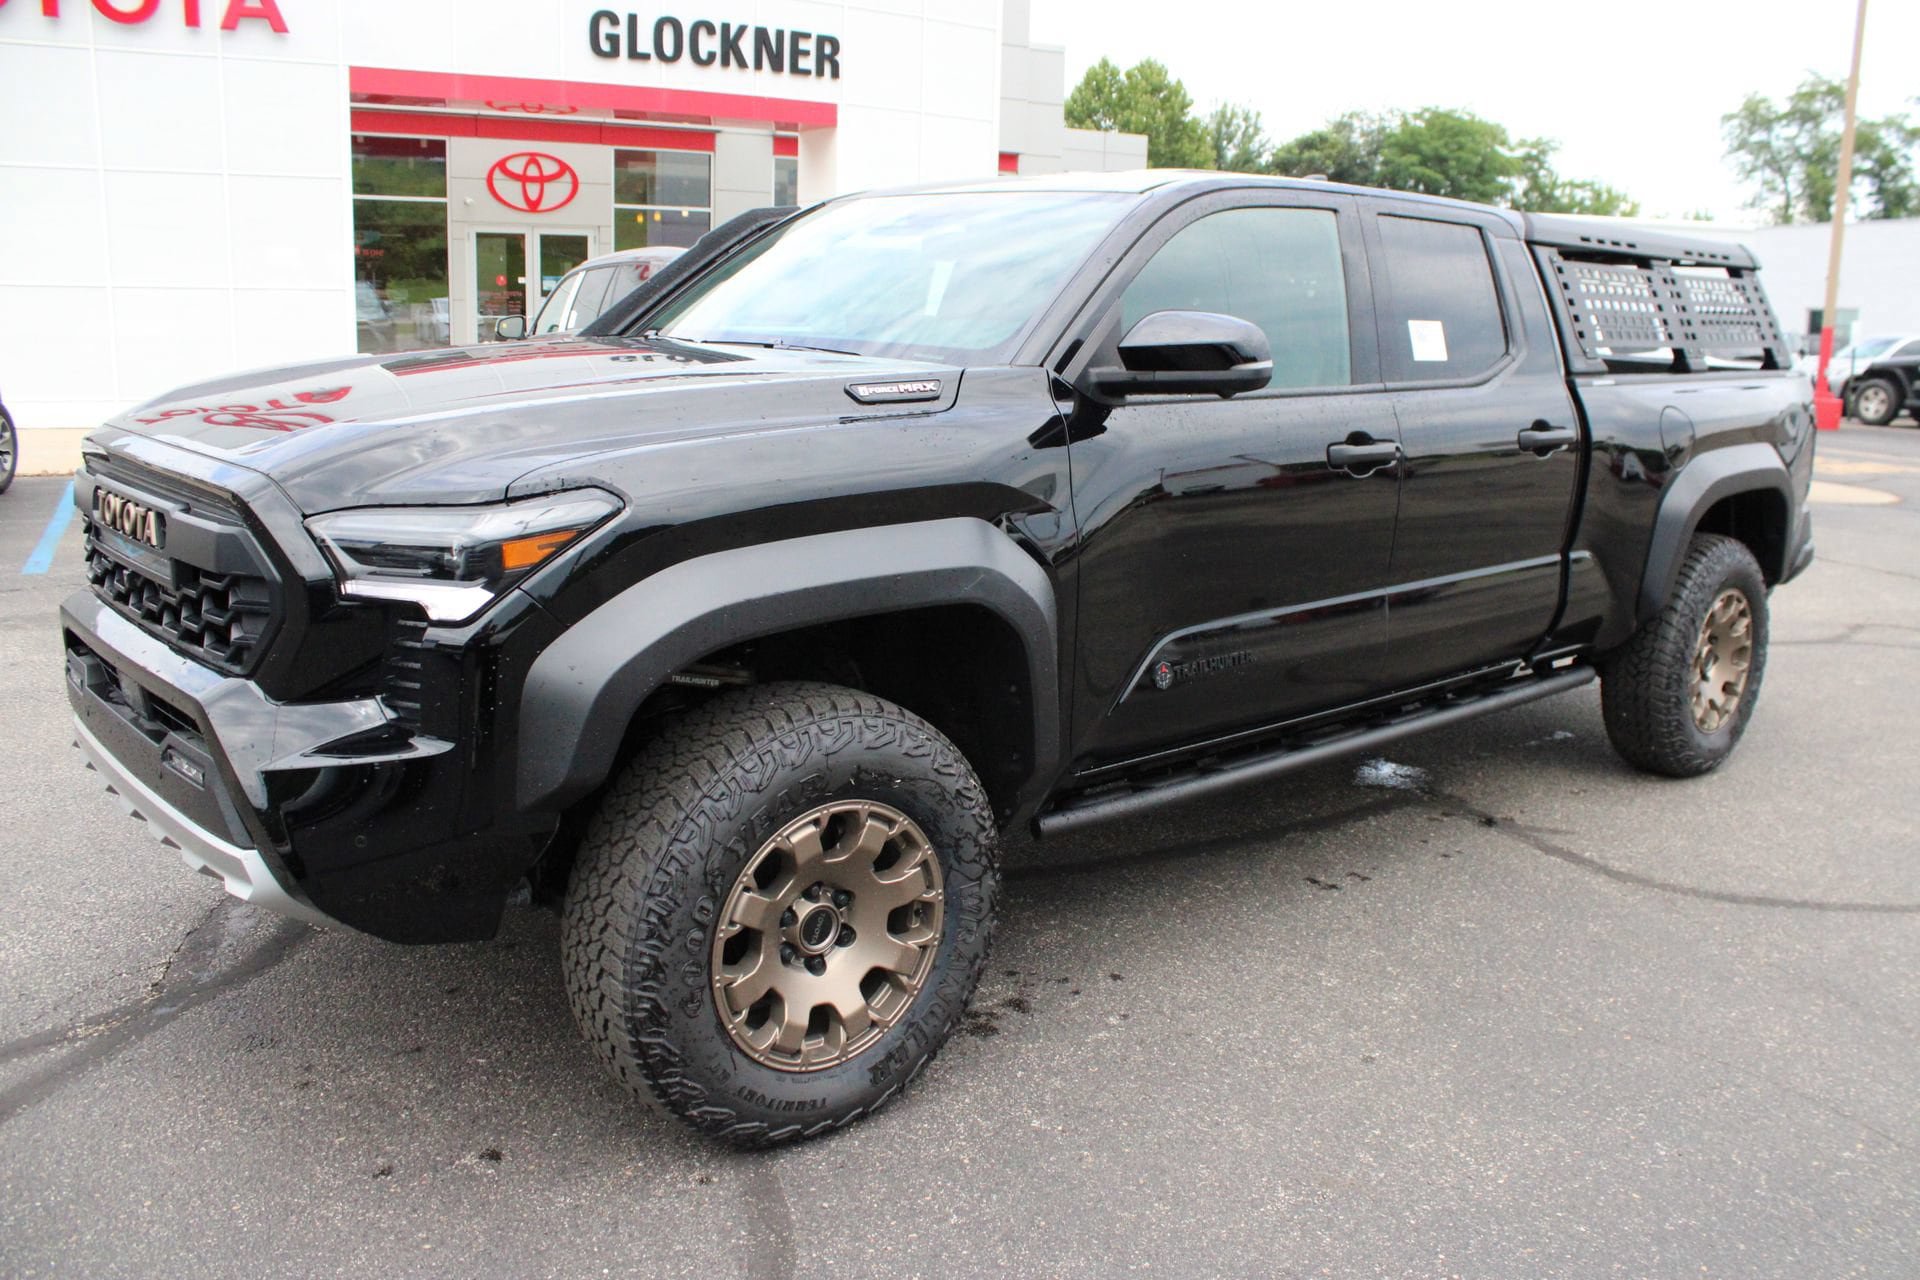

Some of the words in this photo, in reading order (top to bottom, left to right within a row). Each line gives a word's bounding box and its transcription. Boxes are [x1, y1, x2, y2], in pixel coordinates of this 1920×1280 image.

[589, 9, 841, 80] GLOCKNER
[899, 382, 937, 393] MAX
[97, 489, 158, 547] TOYOTA
[810, 912, 827, 945] TOYOTA
[868, 880, 982, 1087] WRANGLER
[737, 1085, 828, 1112] TERRITORY
